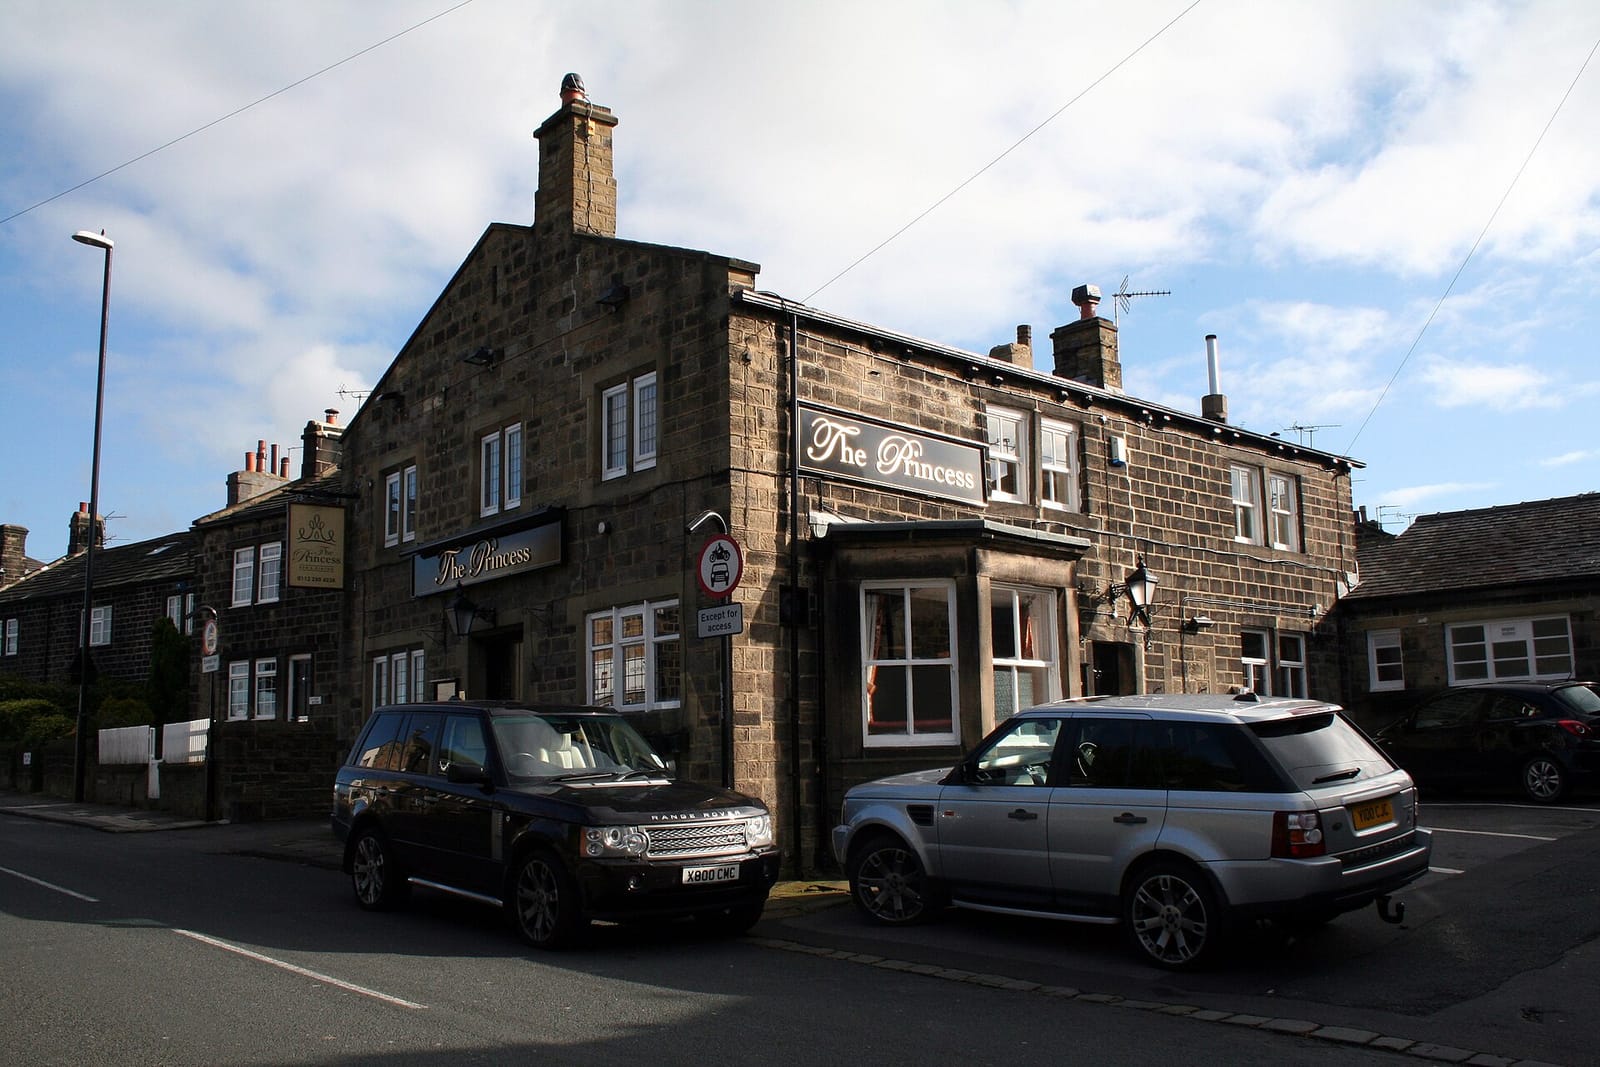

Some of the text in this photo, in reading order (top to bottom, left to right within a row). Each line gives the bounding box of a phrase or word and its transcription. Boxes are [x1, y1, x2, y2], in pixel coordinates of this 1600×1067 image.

[807, 417, 975, 489] The Princess
[292, 548, 342, 565] Princess
[434, 538, 531, 585] The Princess
[701, 610, 738, 622] Except for
[707, 622, 732, 632] access
[651, 810, 741, 821] RANGE ROVER
[687, 867, 735, 882] X800 CMC
